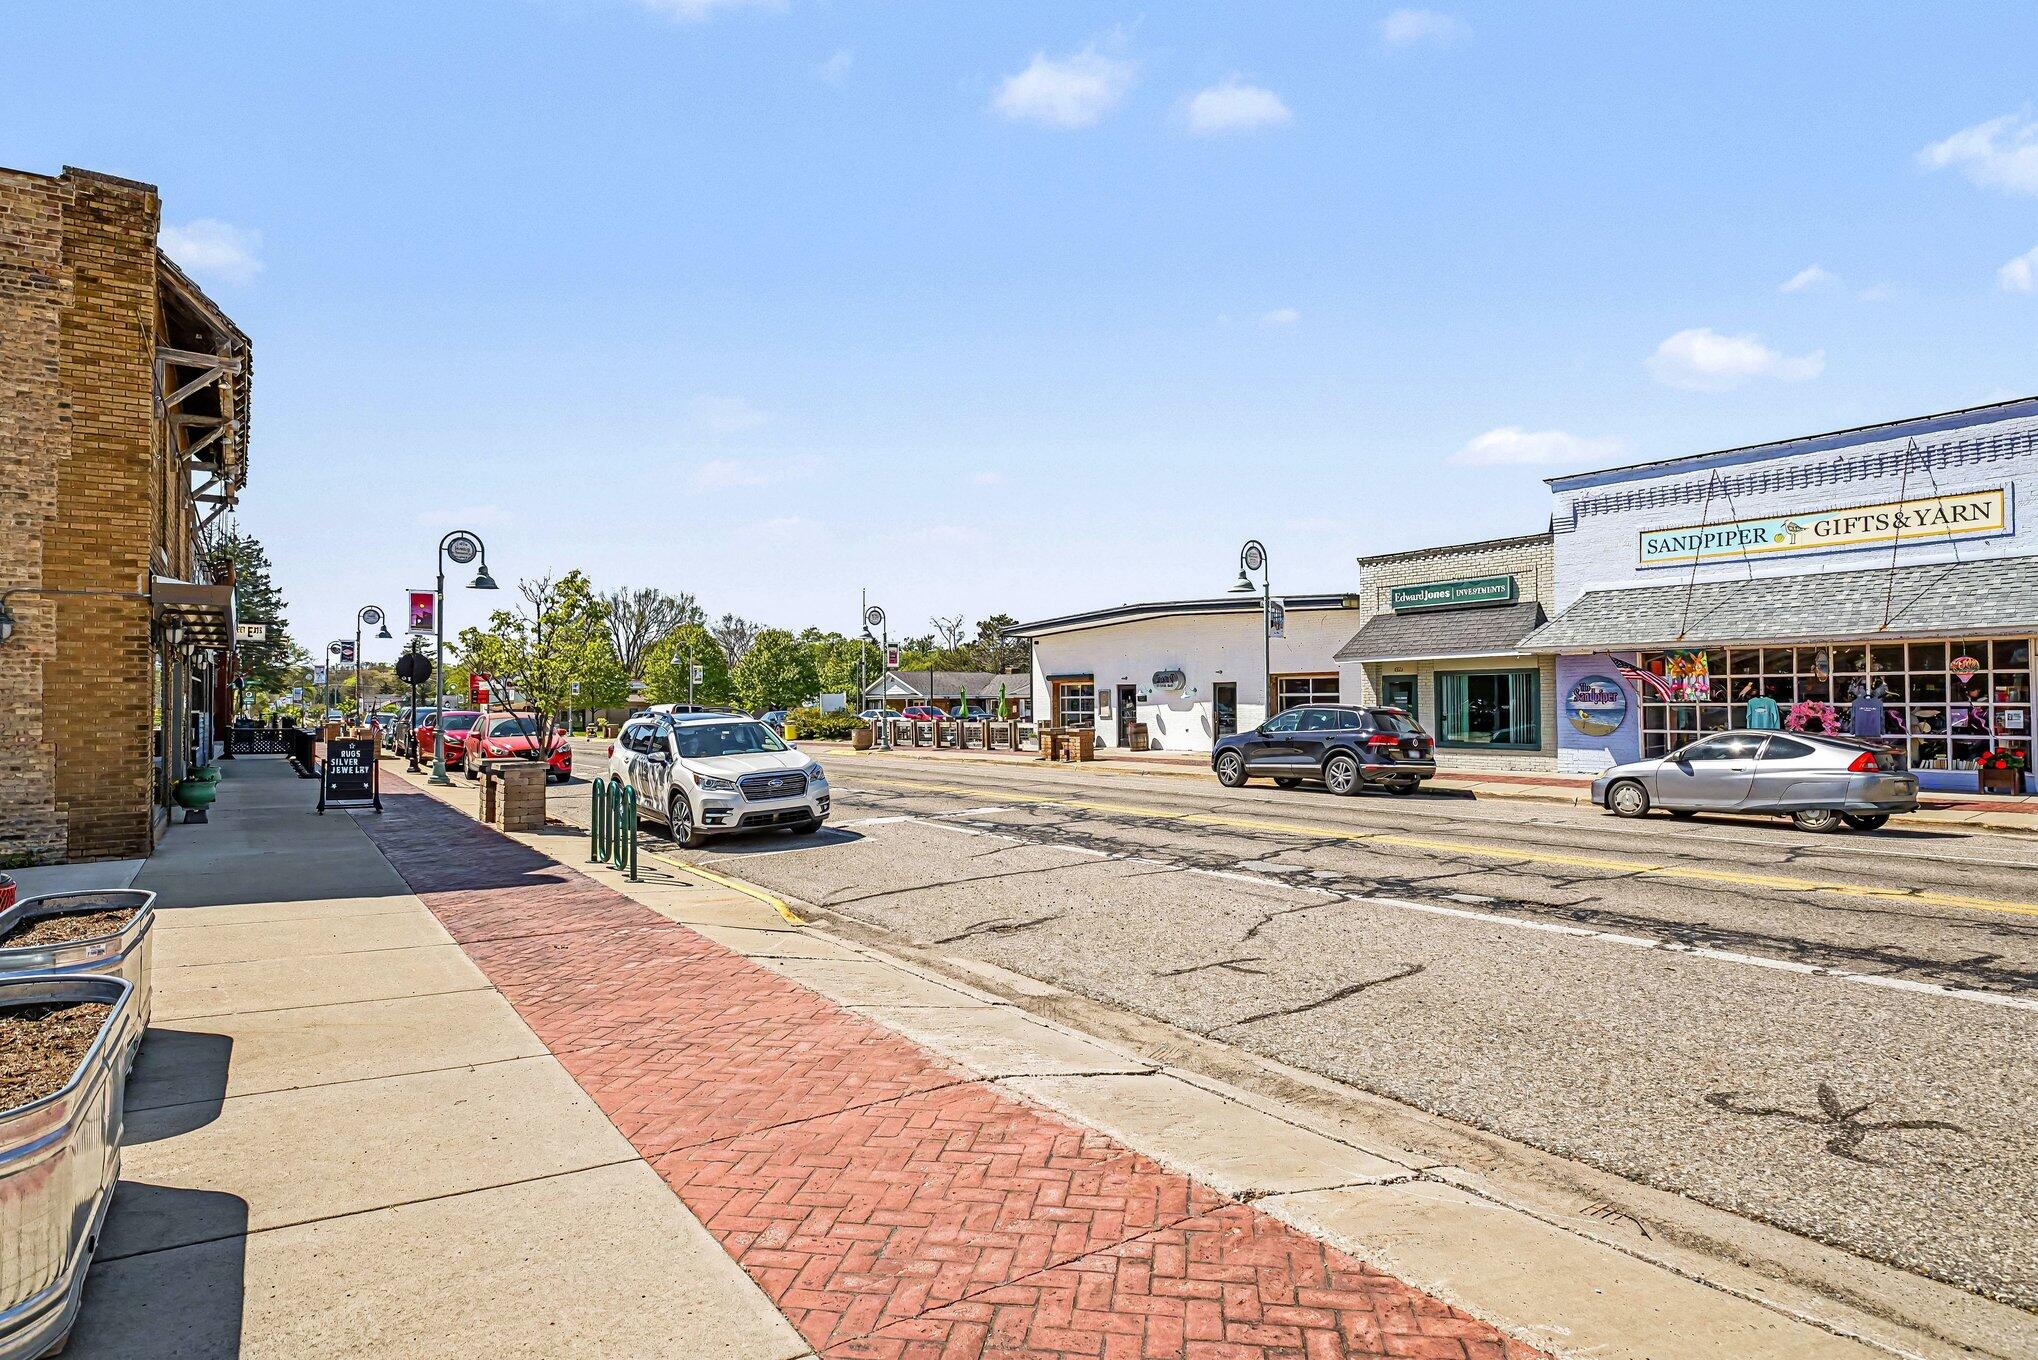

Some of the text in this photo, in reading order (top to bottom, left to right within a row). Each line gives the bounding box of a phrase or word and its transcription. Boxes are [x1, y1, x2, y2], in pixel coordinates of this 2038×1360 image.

[1647, 527, 1769, 554] SANDPIPER
[1456, 585, 1506, 597] INVESTMENTS
[1573, 688, 1618, 704] Sandpiper
[341, 750, 361, 758] RUGS
[330, 758, 358, 766] SILVER
